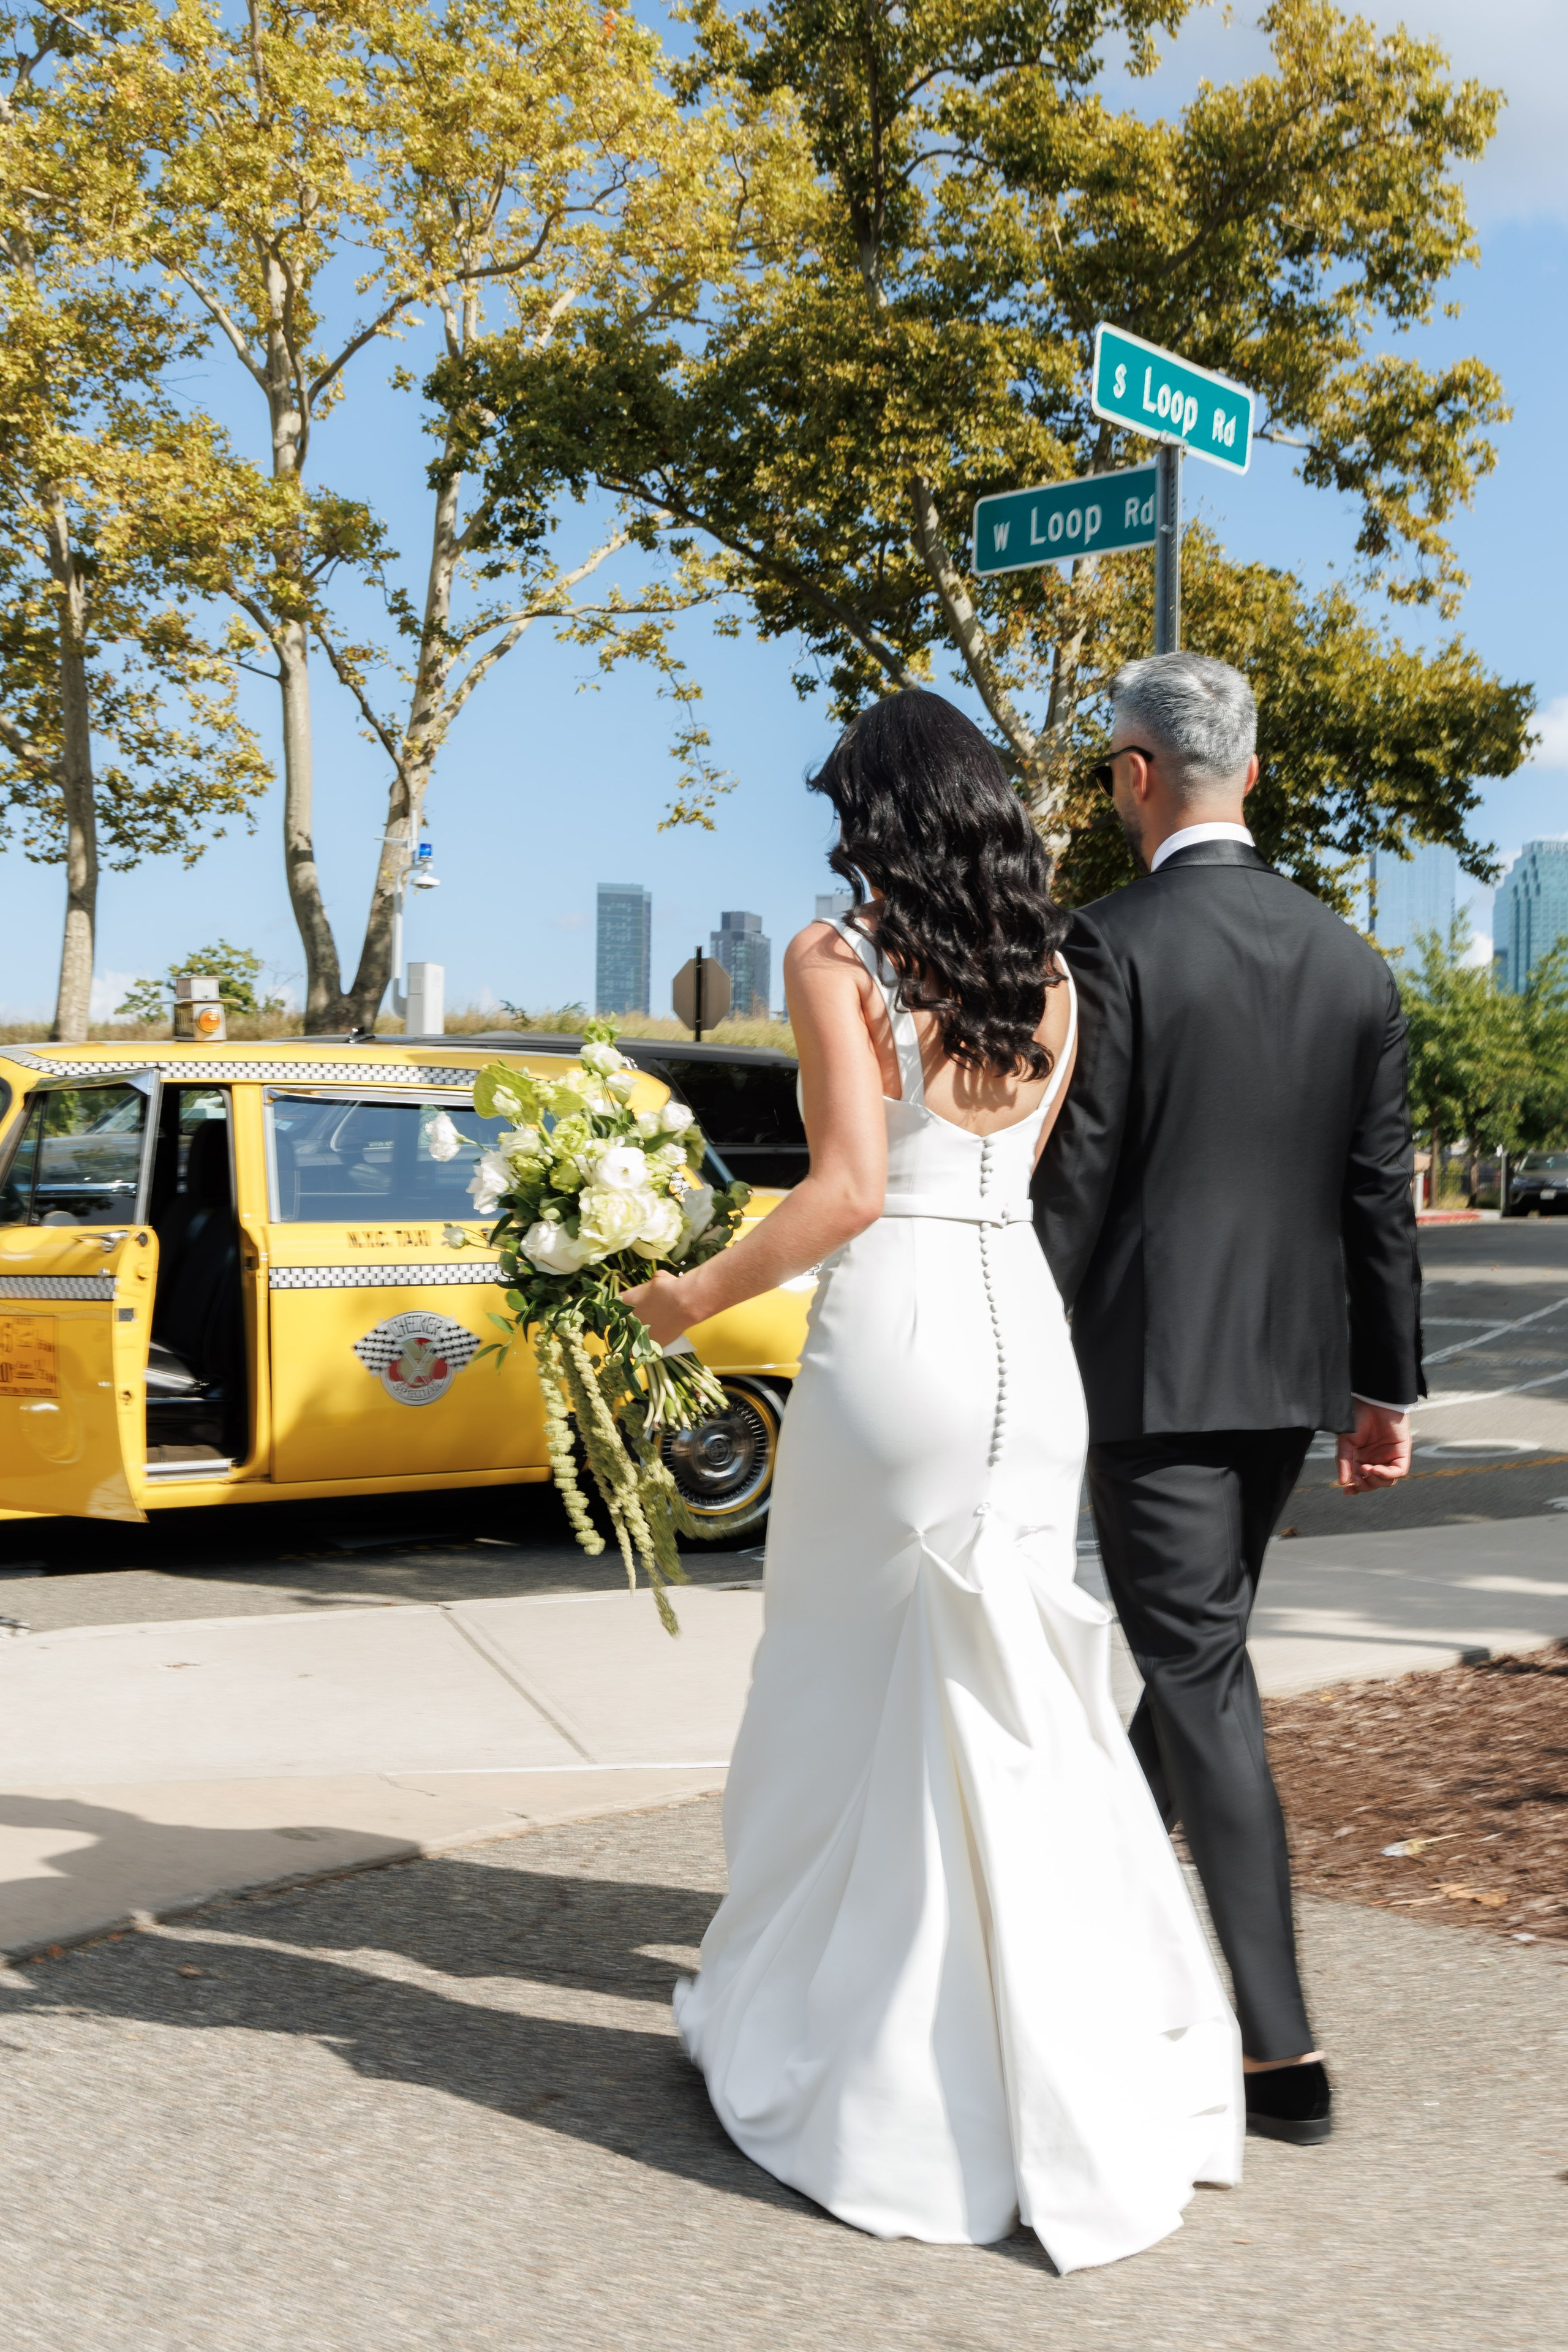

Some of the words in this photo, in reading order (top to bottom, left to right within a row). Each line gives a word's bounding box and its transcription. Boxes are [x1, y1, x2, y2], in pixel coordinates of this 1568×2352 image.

[1114, 363, 1127, 399] S
[1143, 366, 1198, 437] Loop
[1212, 407, 1236, 447] Rd
[993, 521, 1010, 552] W
[1030, 503, 1102, 545] Loop
[1125, 494, 1155, 529] Rd
[393, 1230, 431, 1246] TAXI
[393, 1384, 442, 1398] SPECIAL
